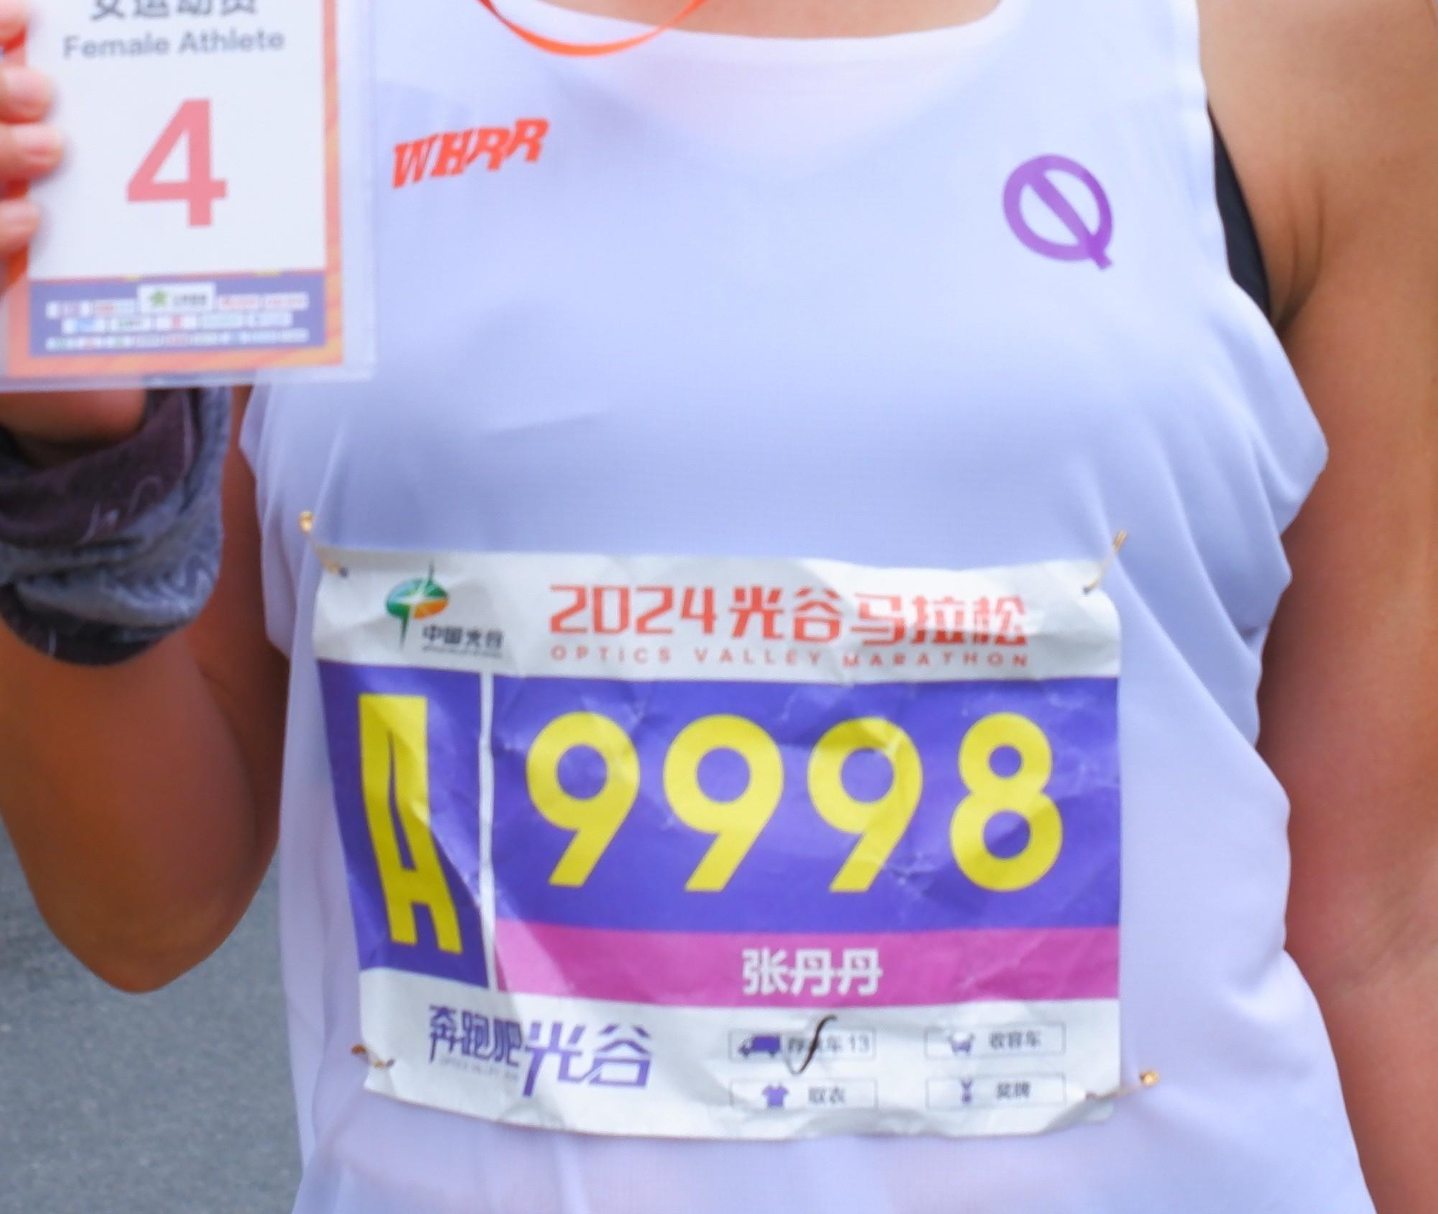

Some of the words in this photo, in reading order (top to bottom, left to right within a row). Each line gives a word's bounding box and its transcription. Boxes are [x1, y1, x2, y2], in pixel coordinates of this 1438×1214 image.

[63, 32, 170, 58] Female
[179, 27, 285, 53] Athlete
[126, 98, 227, 227] 4
[392, 118, 549, 188] WHRR
[551, 644, 671, 665] OPTICS
[693, 647, 822, 669] VALLEY
[842, 650, 1029, 669] MARATHON
[358, 693, 462, 955] A
[526, 712, 1063, 893] 9998
[742, 947, 884, 996] 张丹丹
